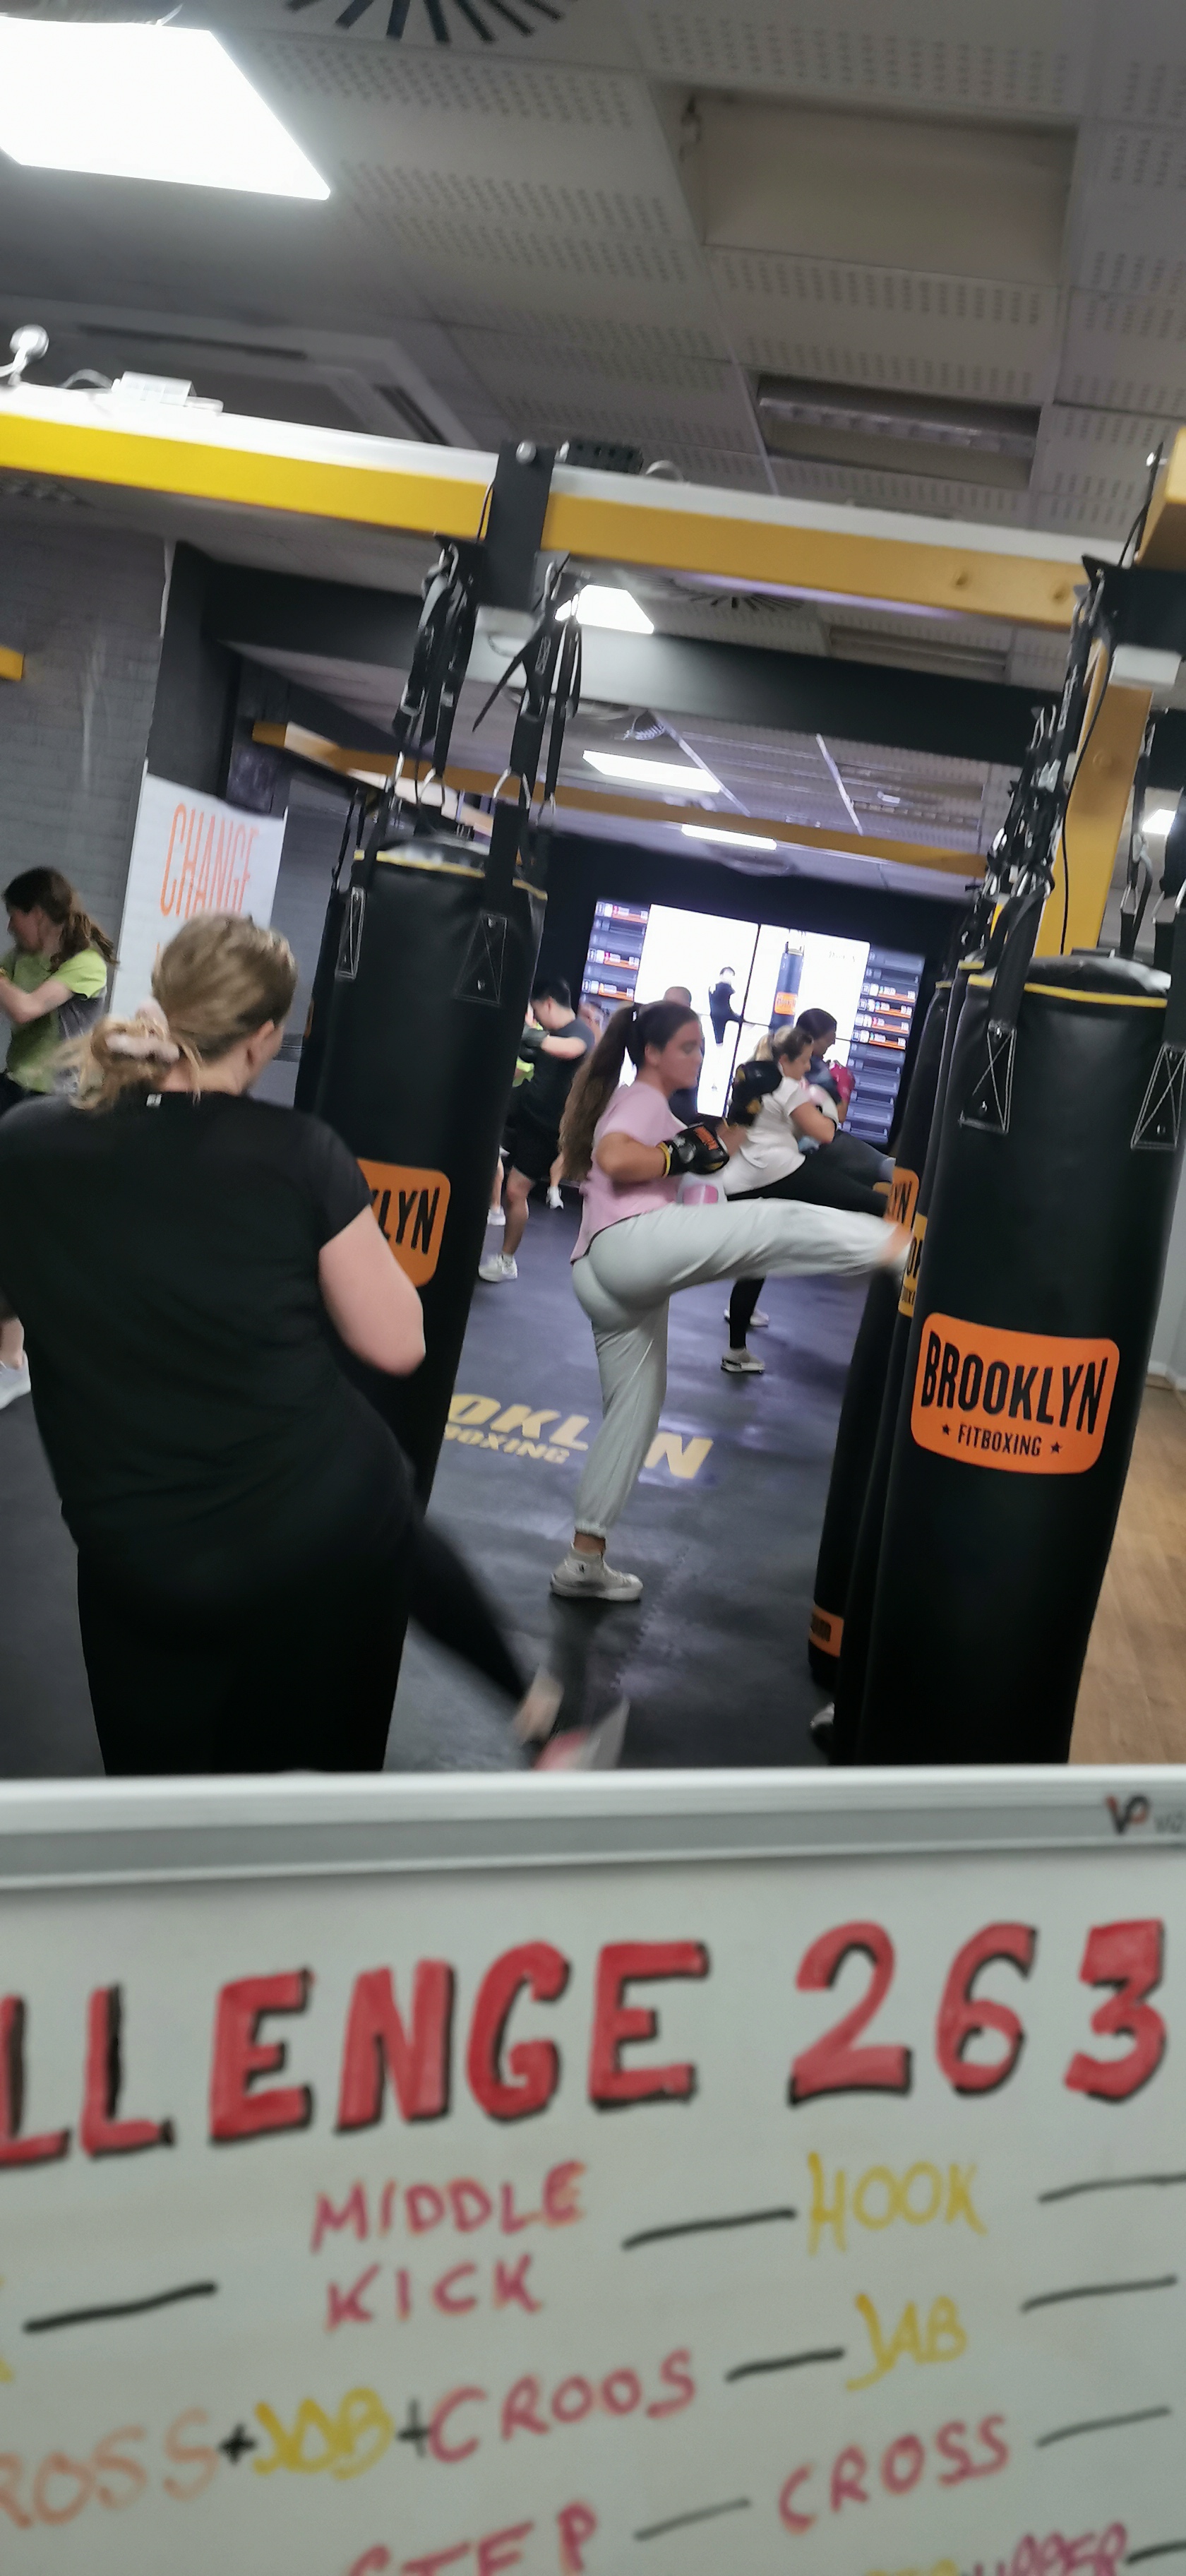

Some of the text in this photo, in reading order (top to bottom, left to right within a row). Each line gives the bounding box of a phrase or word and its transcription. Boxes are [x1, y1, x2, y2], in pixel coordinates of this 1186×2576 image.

[160, 802, 259, 919] CHANGE
[921, 1330, 1108, 1435] BROOKLYN
[957, 1424, 1042, 1456] FITBOXING
[787, 1919, 1166, 2109] 263
[313, 2160, 585, 2254] MIDDLE
[808, 2151, 986, 2255] HOOK
[325, 2255, 541, 2332] KICK
[846, 2294, 968, 2391] JAB
[779, 2416, 1010, 2535] CROSS
